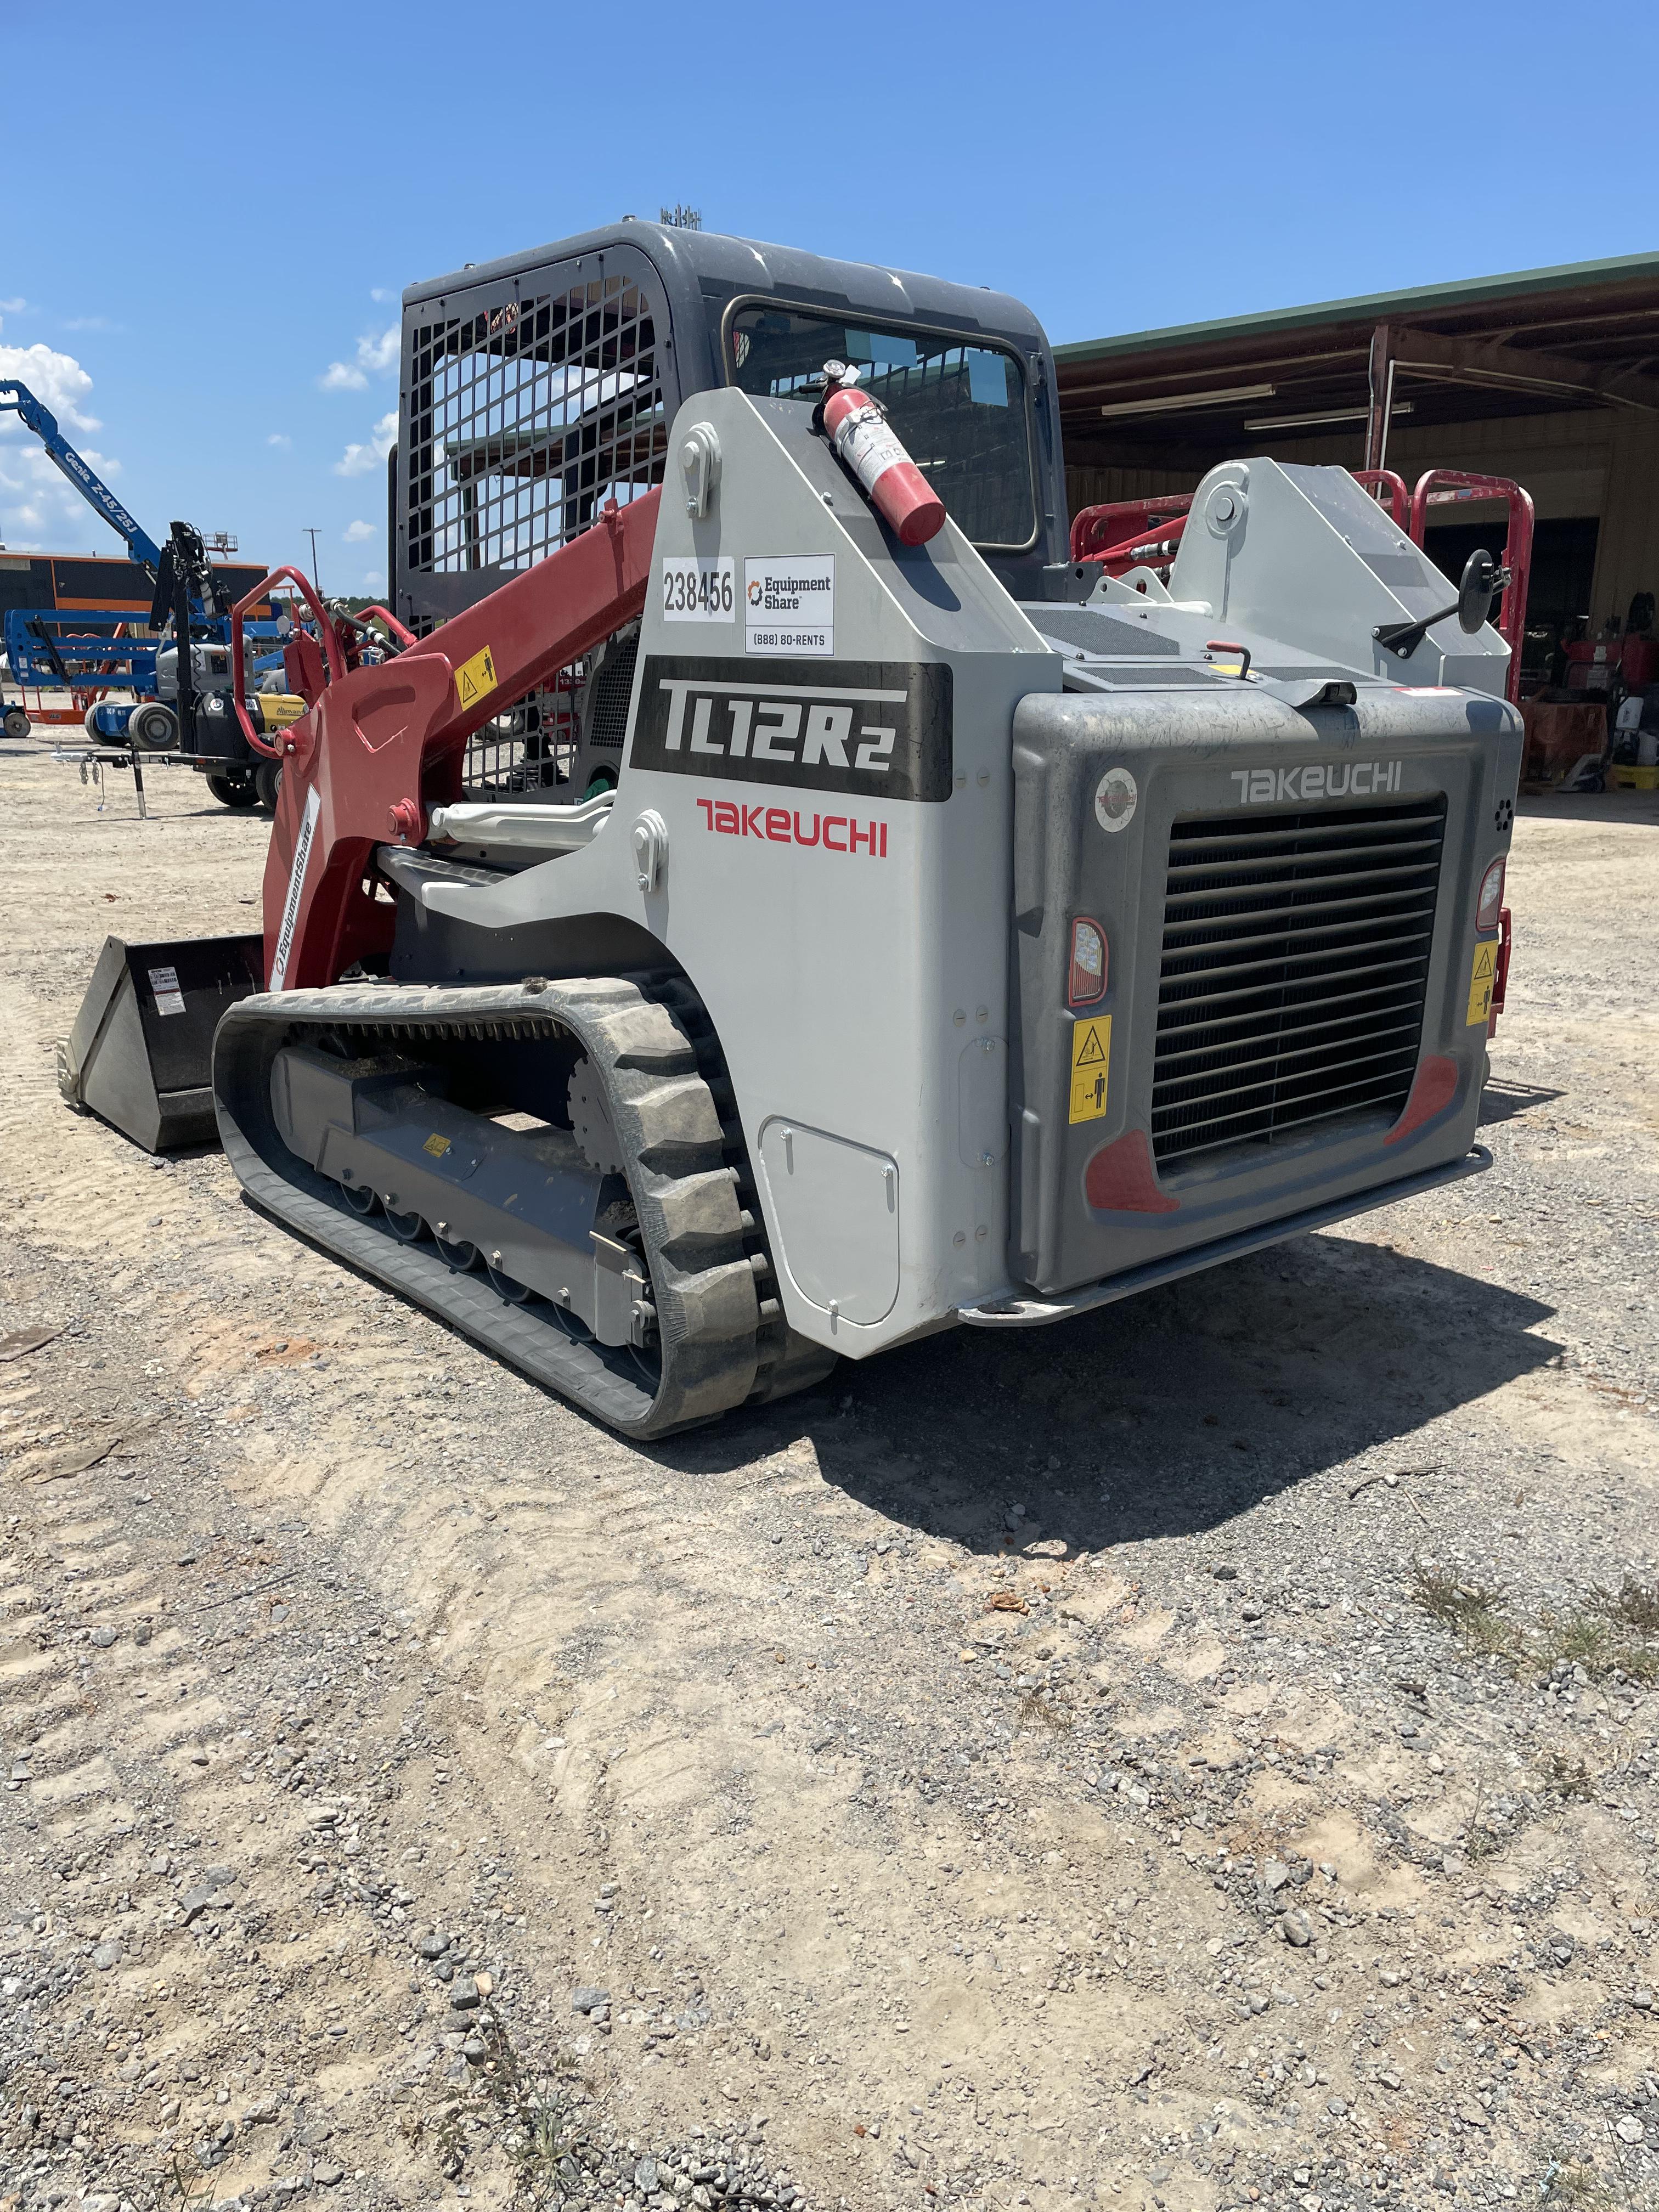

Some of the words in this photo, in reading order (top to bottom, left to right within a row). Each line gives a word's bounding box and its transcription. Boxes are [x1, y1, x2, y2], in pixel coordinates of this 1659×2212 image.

[65, 452, 90, 483] Genie
[91, 483, 138, 533] Z-45/25J
[664, 571, 732, 612] 238456
[765, 576, 831, 594] Equipment
[754, 633, 777, 646] (888)
[781, 634, 825, 646] 80-RENTS
[659, 679, 908, 771] TL12R2
[1231, 761, 1402, 803] TAKEUCHI
[696, 798, 887, 858] TAKEUCHI
[279, 821, 312, 960] EquipmentShare
